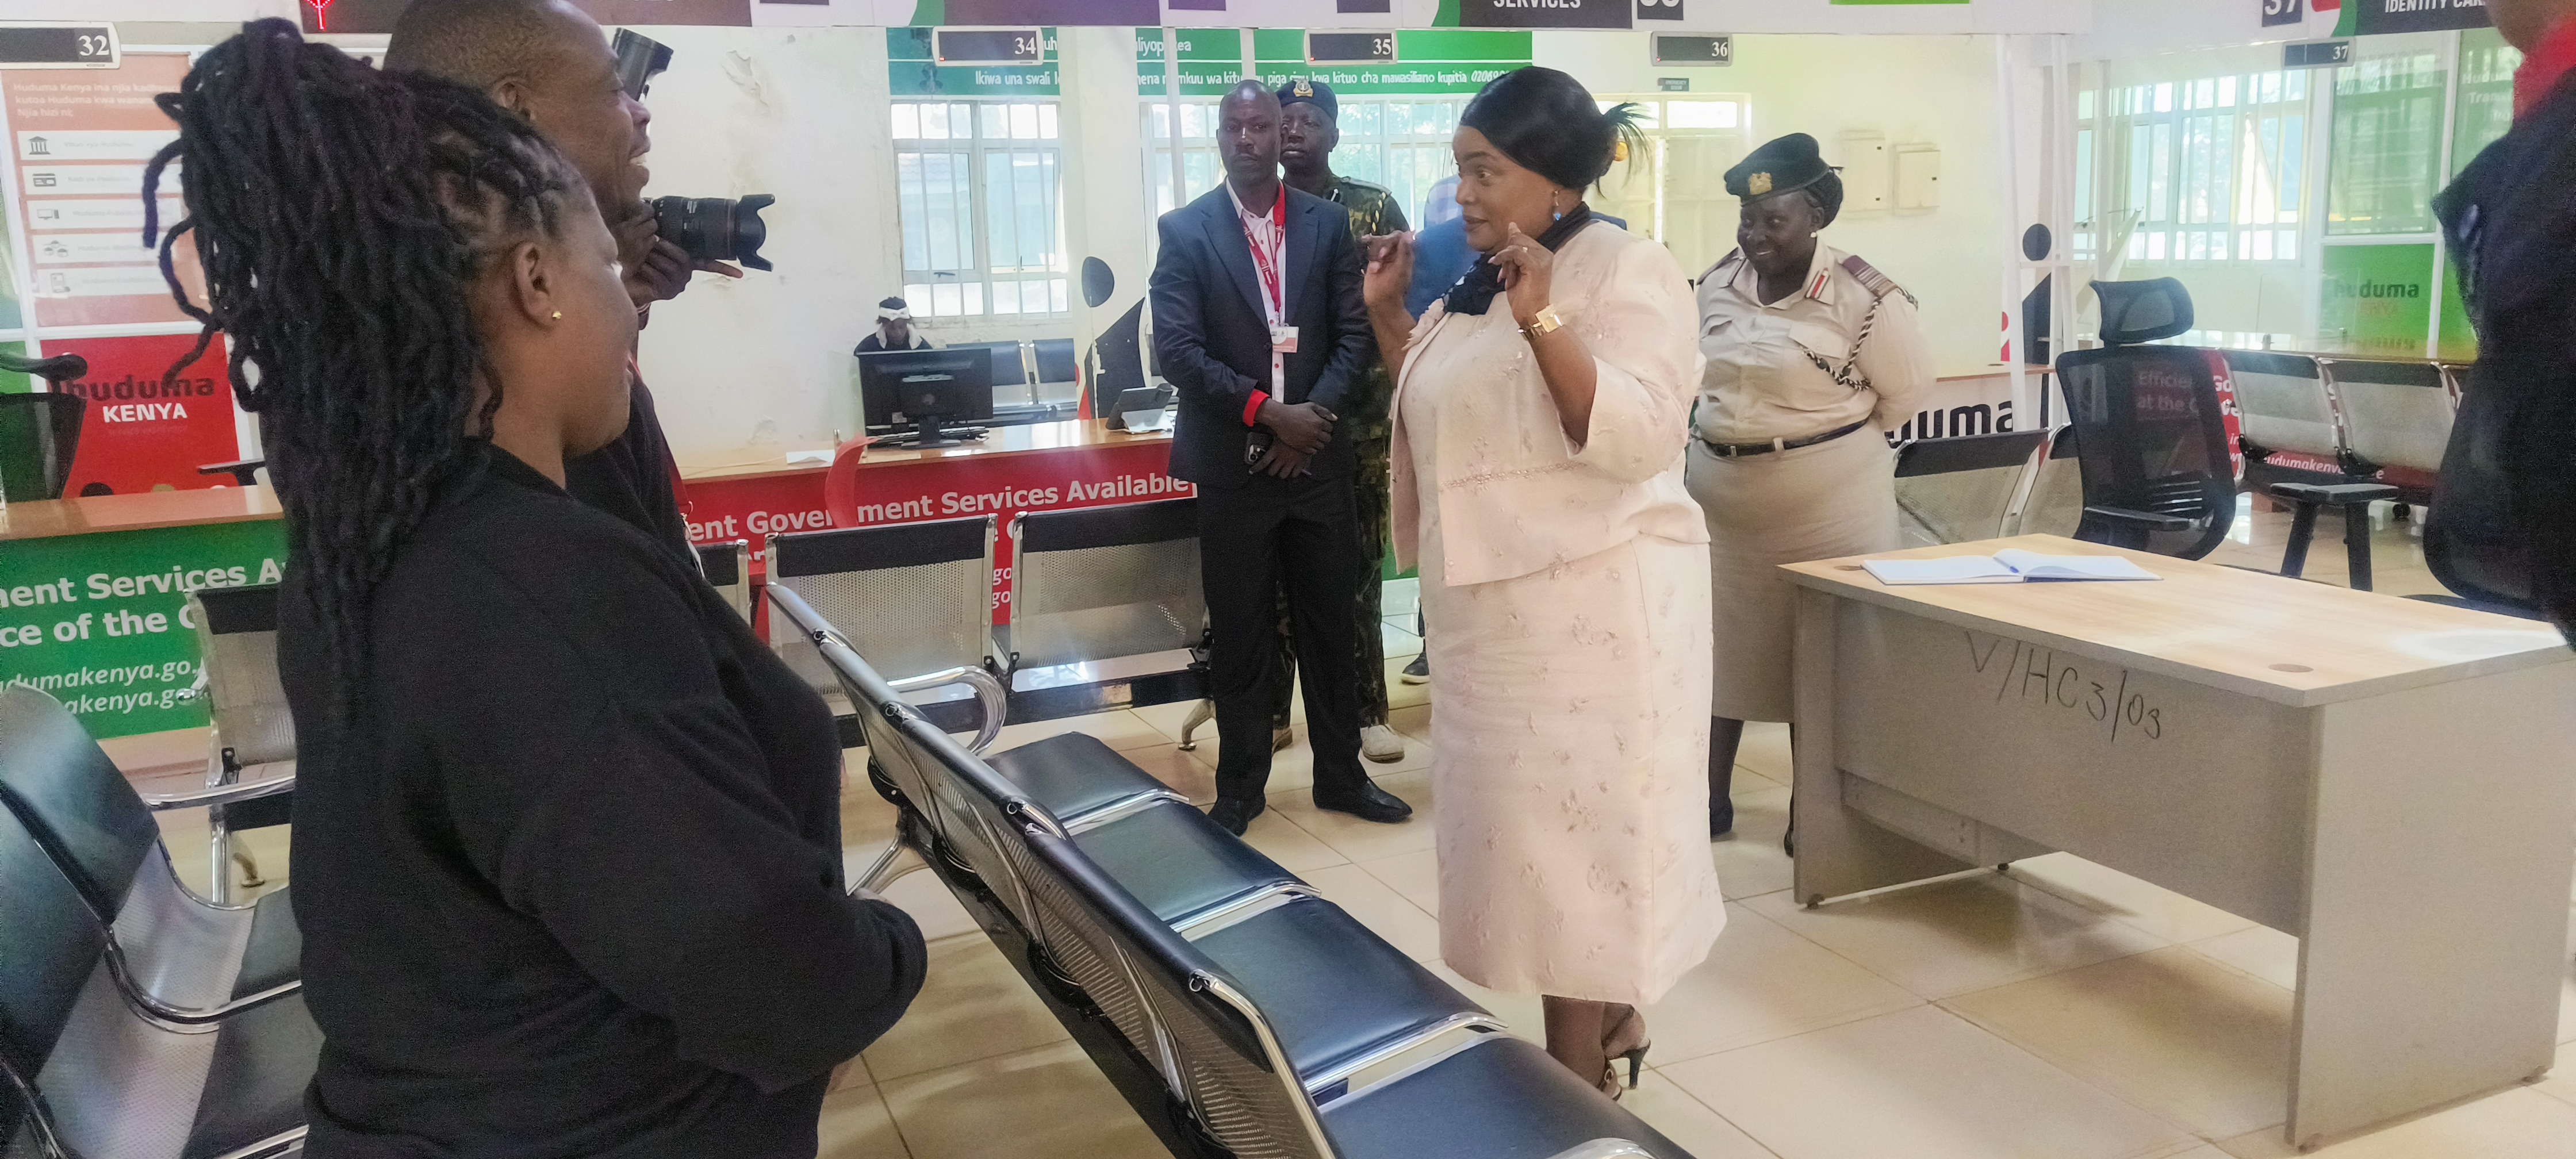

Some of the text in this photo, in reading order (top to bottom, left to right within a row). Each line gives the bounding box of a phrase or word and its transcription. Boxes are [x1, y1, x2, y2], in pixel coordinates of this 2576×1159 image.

[78, 35, 109, 56] 32
[1014, 36, 1037, 55] 34
[1373, 38, 1392, 55] 35
[1711, 41, 1728, 57] 36
[2332, 44, 2349, 61] 37
[975, 70, 1001, 85] Ikiwa
[1005, 75, 1023, 85] una
[1026, 71, 1051, 85] swali
[1206, 74, 1222, 85] wa
[1224, 71, 1243, 85] kitu
[1267, 71, 1287, 88] piga
[1312, 71, 1329, 83] kwa
[1332, 71, 1358, 84] kituo
[1361, 71, 1378, 84] cha
[1438, 70, 1467, 86] kupitia
[13, 83, 57, 92] Huduma
[60, 83, 91, 94] Kenya
[94, 83, 110, 91] ina
[48, 95, 91, 104] Huduma
[94, 95, 114, 104] kwa
[102, 402, 187, 423] KENYA
[941, 486, 1059, 514] Services
[1066, 473, 1189, 502] Available
[86, 565, 247, 600] Services
[53, 612, 93, 642] of
[102, 609, 167, 636] the
